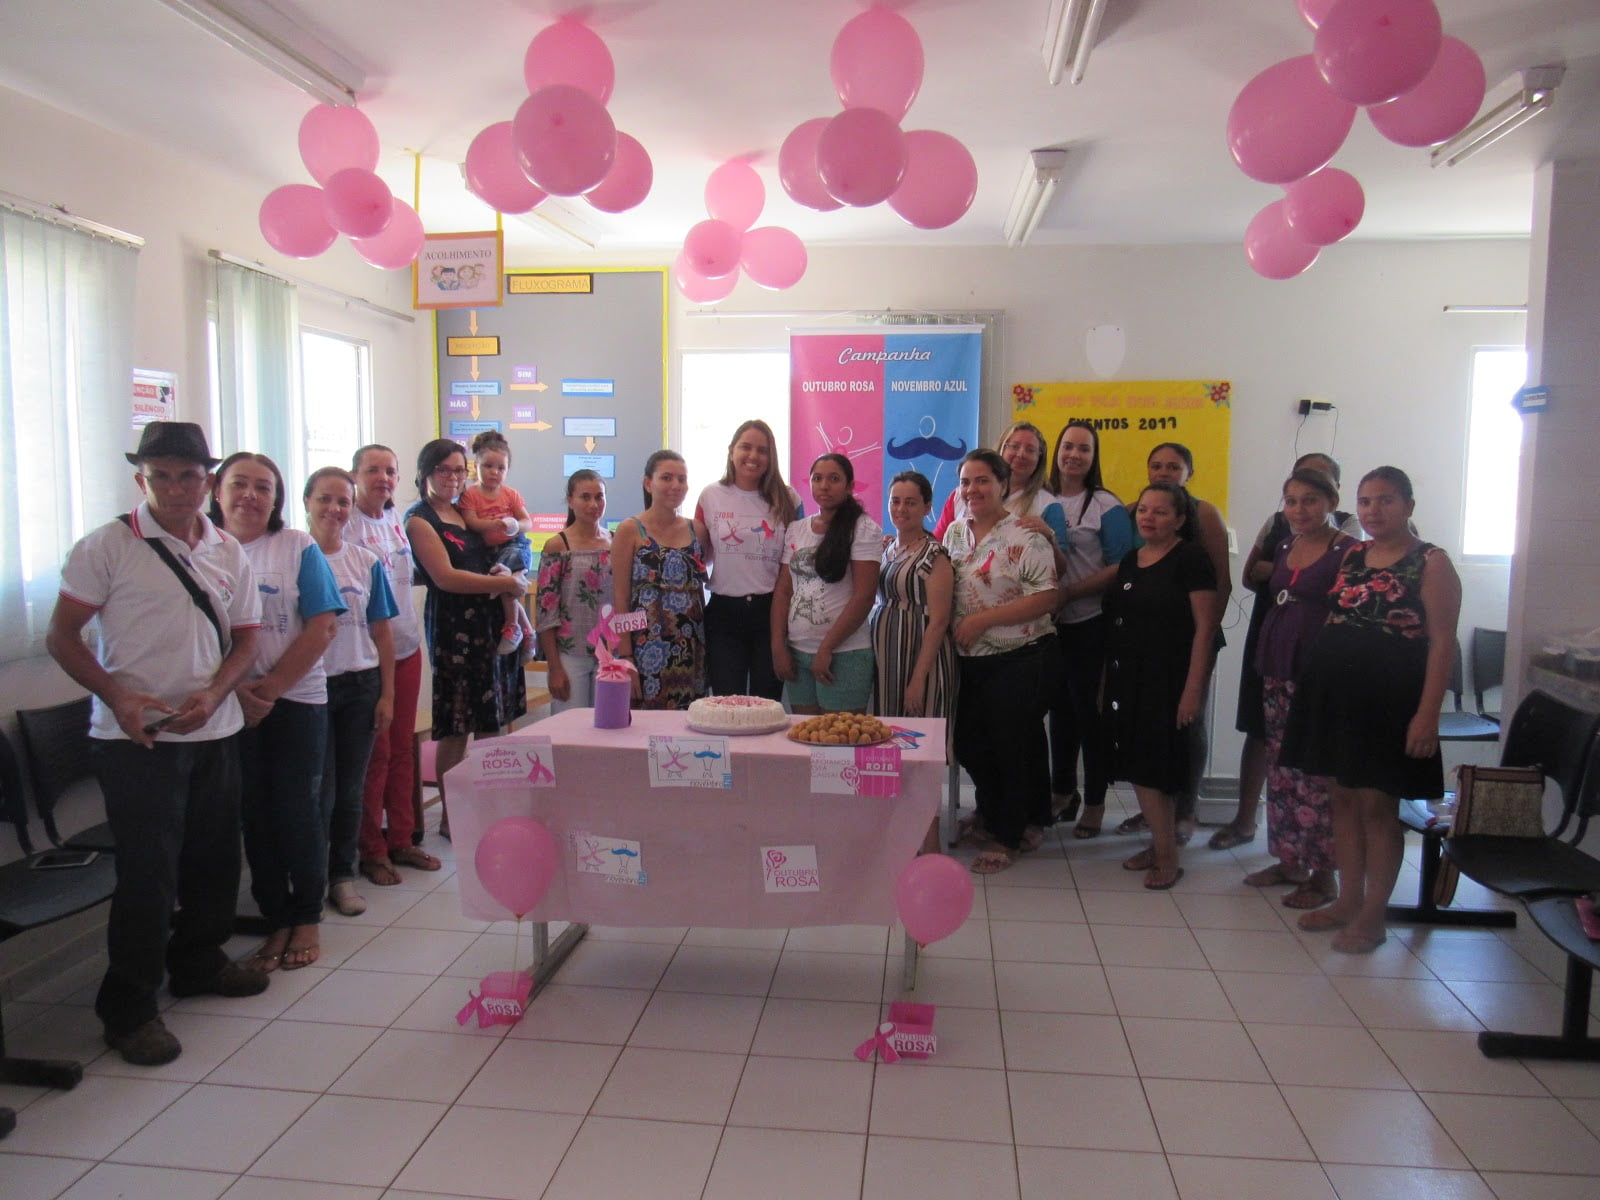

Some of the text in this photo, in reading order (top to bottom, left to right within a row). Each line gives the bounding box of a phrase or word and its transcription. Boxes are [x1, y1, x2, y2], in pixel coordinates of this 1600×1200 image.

[425, 249, 492, 260] ACOLHIMENTO
[511, 279, 590, 291] FLUXOGRAMA
[838, 347, 931, 365] Campanha
[802, 380, 875, 393] OUTUBRO ROSA
[891, 380, 968, 392] NOVEMBRO AZUL
[450, 400, 467, 408] NÃO
[614, 618, 648, 634] ROSA
[482, 758, 522, 770] ROSA
[774, 868, 818, 877] OUTUBRO
[775, 875, 819, 888] ROSA
[486, 1003, 521, 1016] ROSA
[893, 1040, 936, 1053] ROSA
